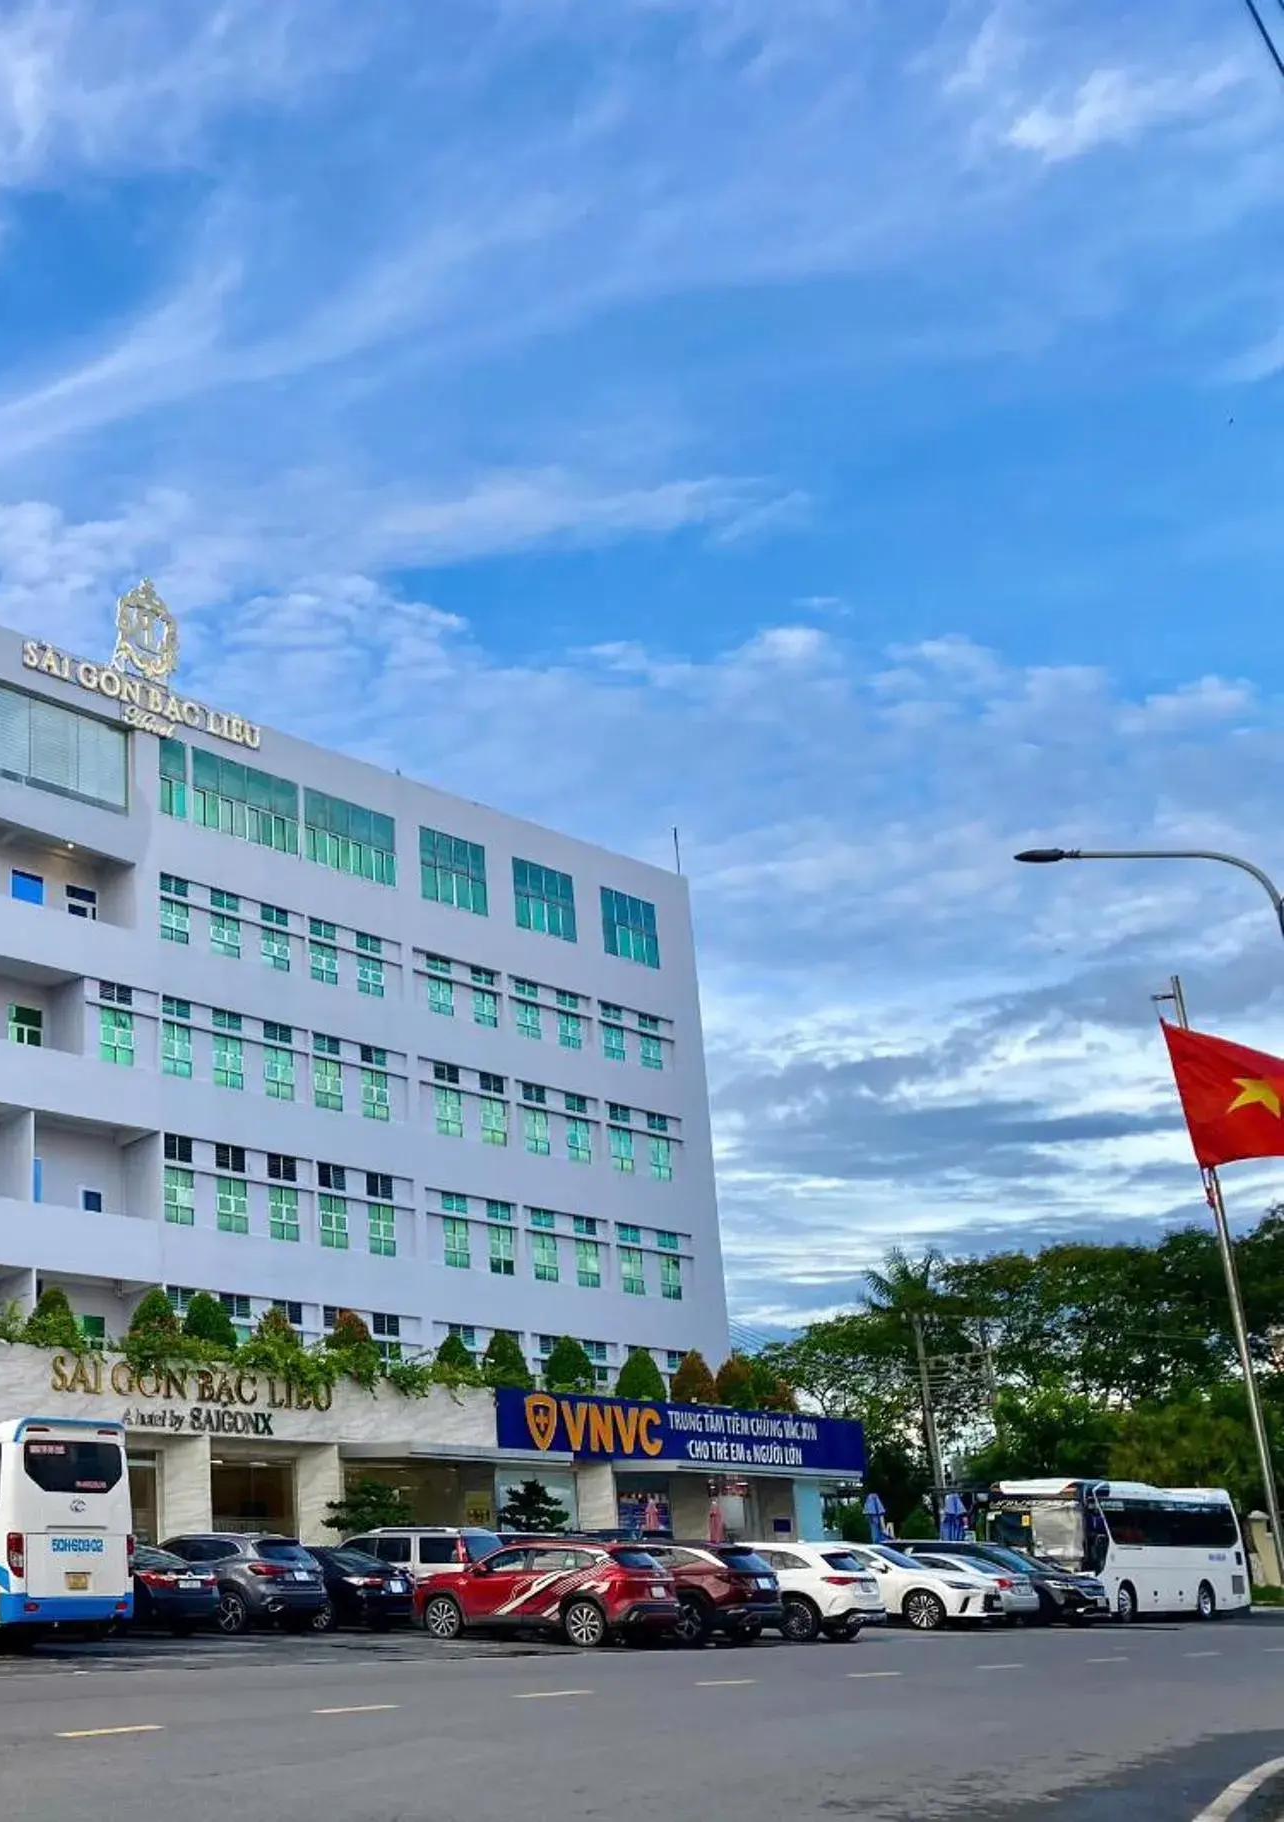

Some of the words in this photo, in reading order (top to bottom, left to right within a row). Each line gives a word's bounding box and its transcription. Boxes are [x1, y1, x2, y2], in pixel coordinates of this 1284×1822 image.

[169, 1409, 185, 1431] by
[189, 1407, 273, 1435] SAIGONX
[561, 1401, 663, 1456] VNVC
[668, 1411, 703, 1432] TRUNG
[704, 1409, 725, 1433] TÂM
[689, 1439, 710, 1459] CHO
[731, 1442, 745, 1462] EM
